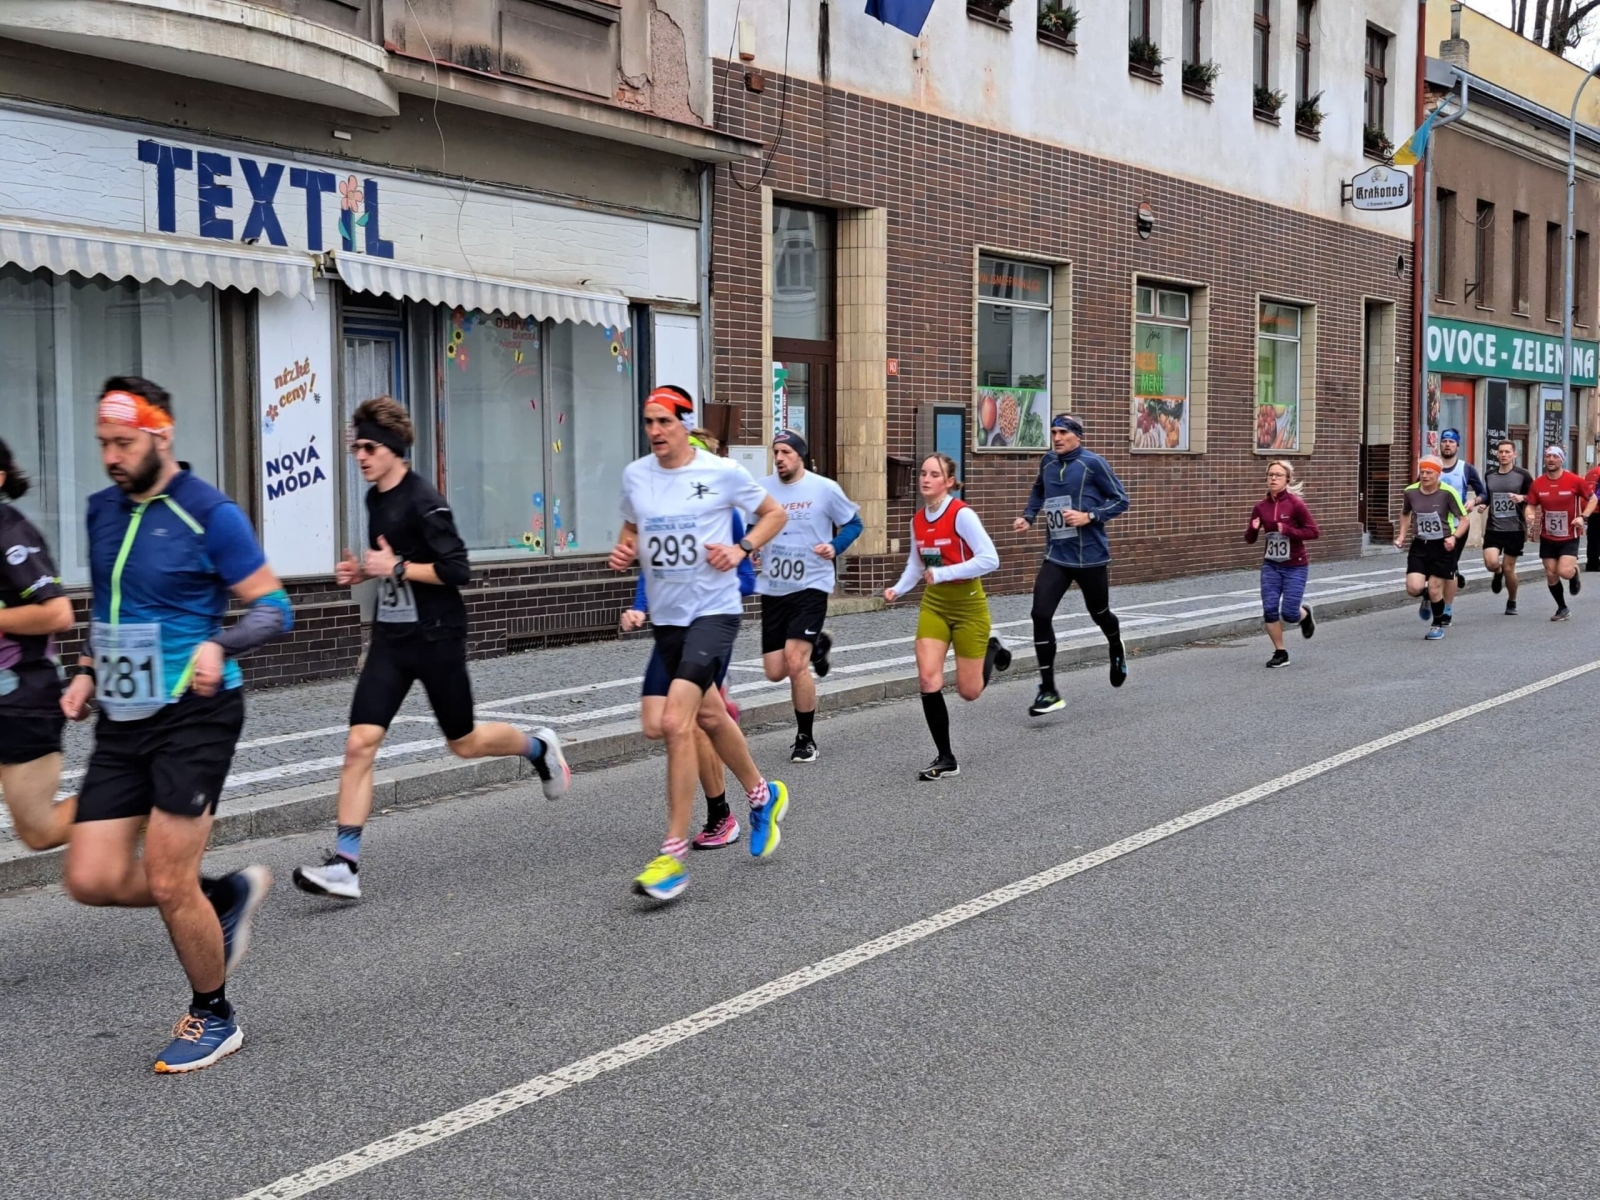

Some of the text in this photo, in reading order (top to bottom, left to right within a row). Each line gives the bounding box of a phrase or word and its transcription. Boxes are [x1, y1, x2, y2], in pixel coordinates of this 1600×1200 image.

[138, 139, 394, 259] TEXTIL
[1356, 183, 1404, 200] Krakonoš
[1427, 325, 1497, 367] OVOCE
[274, 357, 311, 390] nízké
[1141, 374, 1165, 393] MENU
[279, 373, 316, 408] ceny!
[266, 435, 320, 478] NOVÁ
[266, 466, 326, 501] MÓDA
[1047, 510, 1064, 529] 30
[1495, 500, 1515, 511] 232
[1420, 521, 1441, 533] 183
[1550, 519, 1563, 531] 51
[648, 534, 698, 567] 293
[1268, 541, 1288, 556] 313
[769, 557, 805, 581] 309
[101, 655, 155, 699] 281
